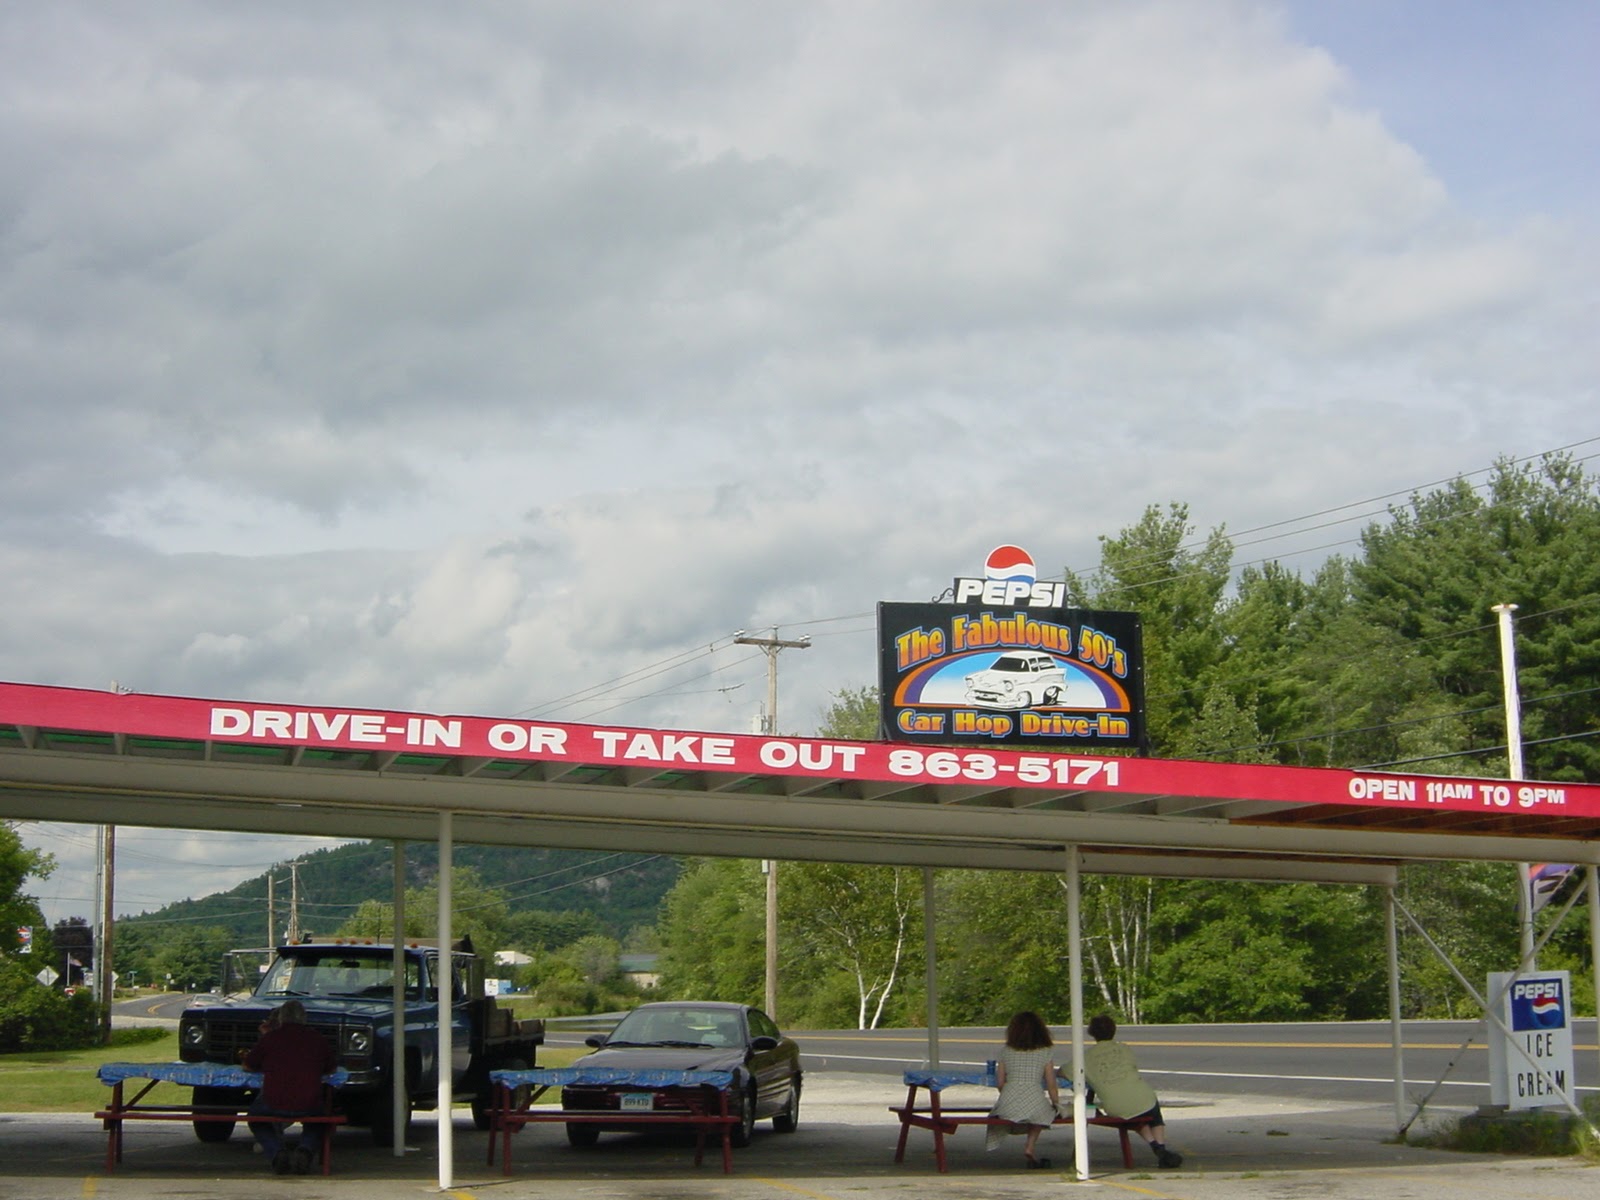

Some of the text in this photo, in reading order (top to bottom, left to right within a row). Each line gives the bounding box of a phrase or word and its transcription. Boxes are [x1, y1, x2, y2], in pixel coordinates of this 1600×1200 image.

[956, 579, 1066, 607] PEPSI
[895, 612, 1127, 678] The Fabulous 50's
[898, 709, 1130, 738] Car Hop Drive-In
[210, 707, 1119, 787] DRIVE-IN OR TAKE OUT 863-5171
[1349, 778, 1565, 808] OPEN 11AM TO 9PM
[1514, 982, 1560, 1000] PEPSI
[1527, 1033, 1553, 1058] ICE
